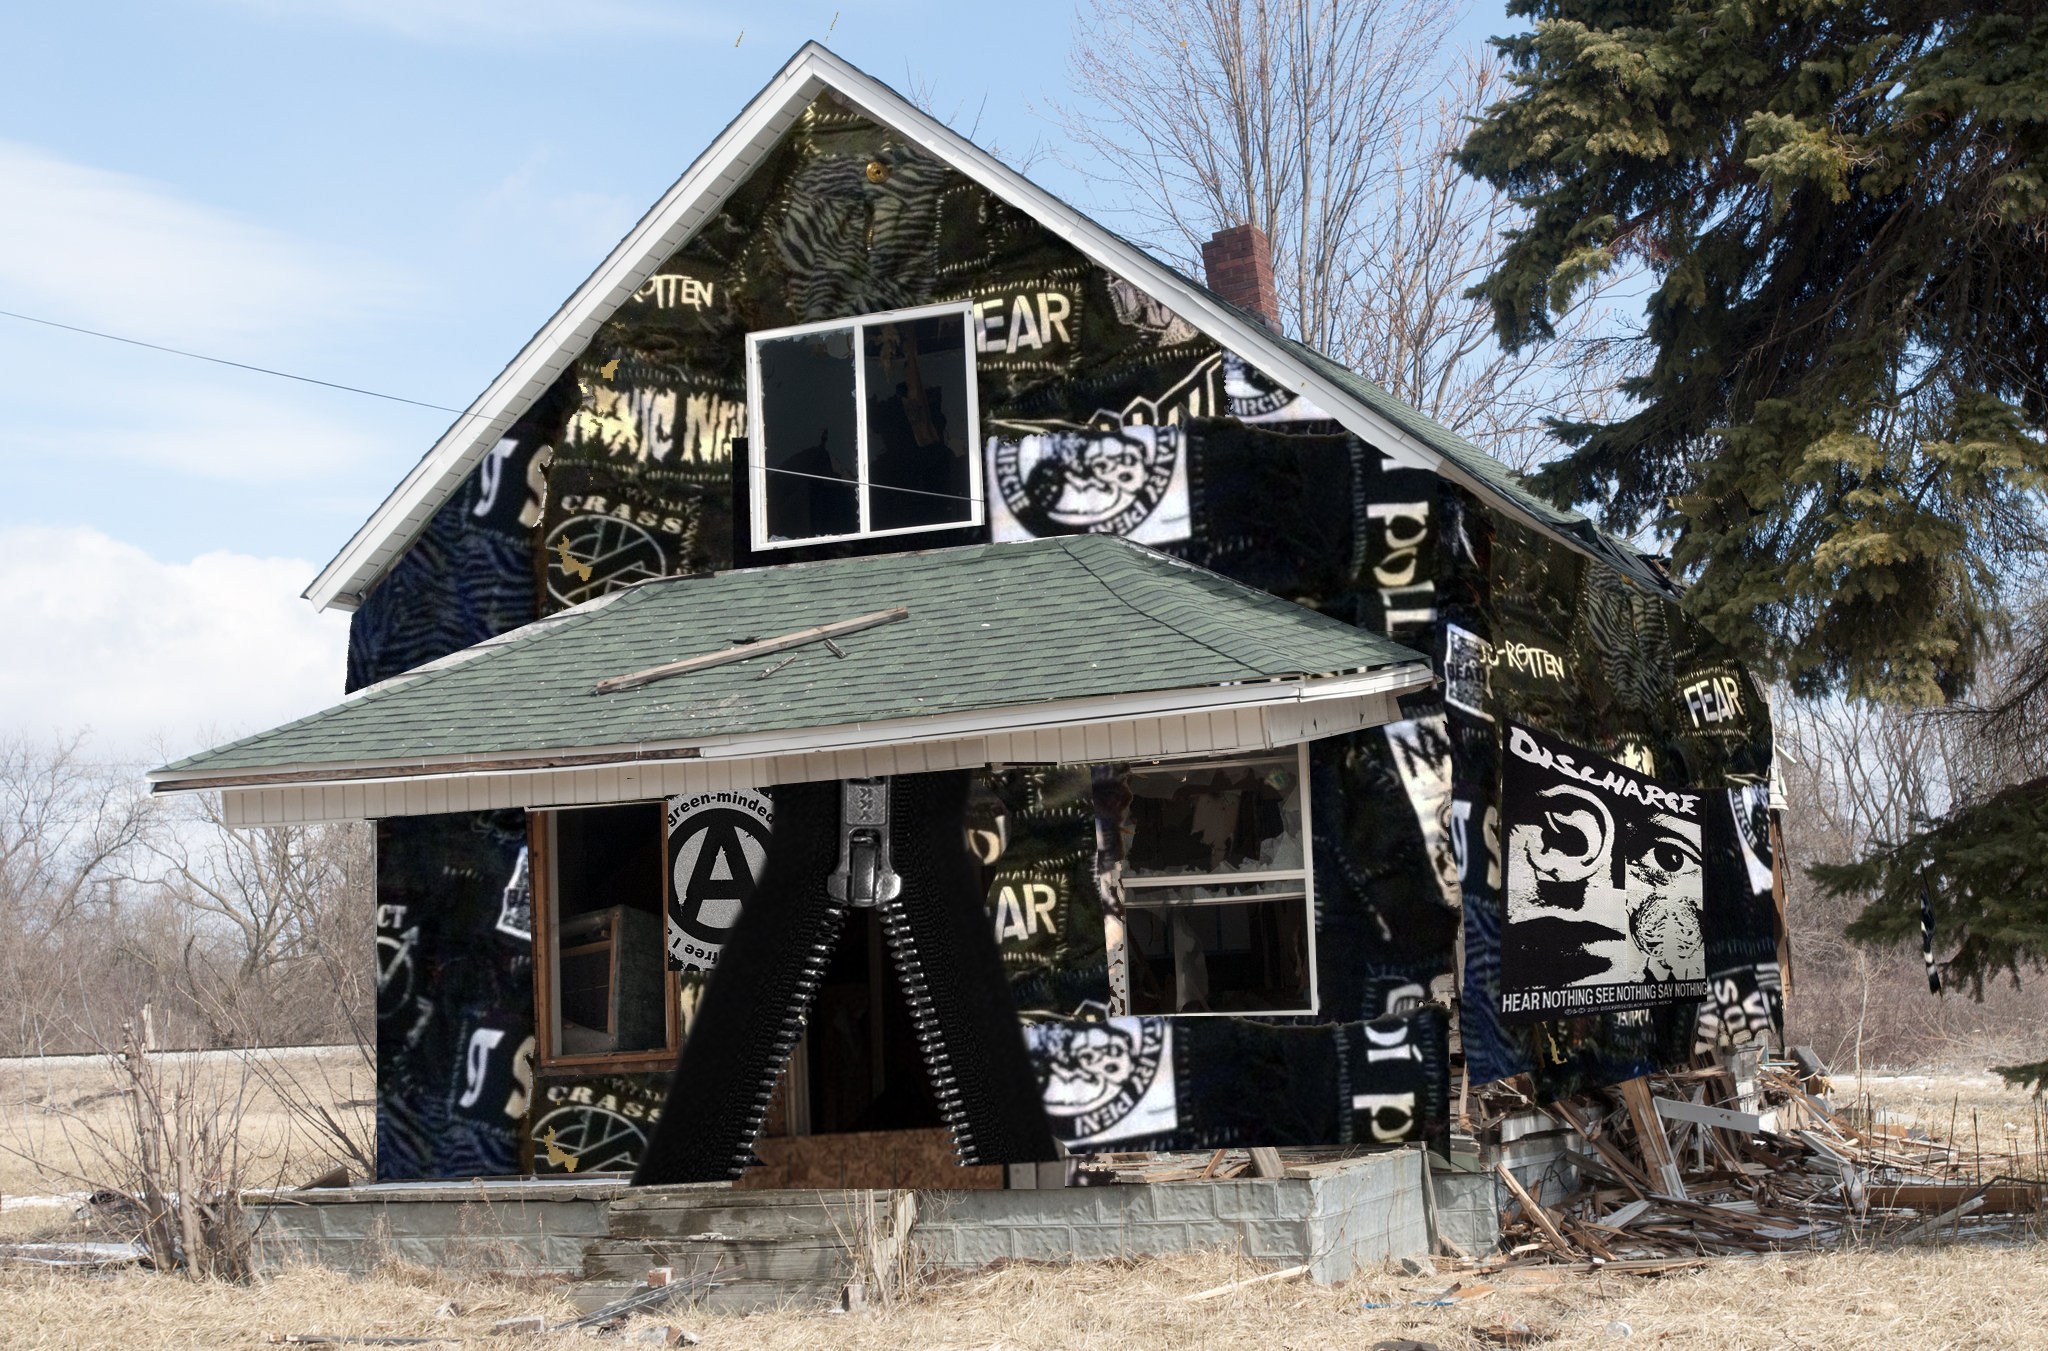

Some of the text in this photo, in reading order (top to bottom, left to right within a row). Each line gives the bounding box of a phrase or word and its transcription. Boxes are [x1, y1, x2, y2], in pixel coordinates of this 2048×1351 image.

[560, 494, 684, 535] CRASS
[1684, 676, 1744, 727] FEAR
[1509, 726, 1700, 816] DISCHARGE
[1502, 981, 1707, 1013] HEAR NOTHING SEE NOTHING SAY NOTHING
